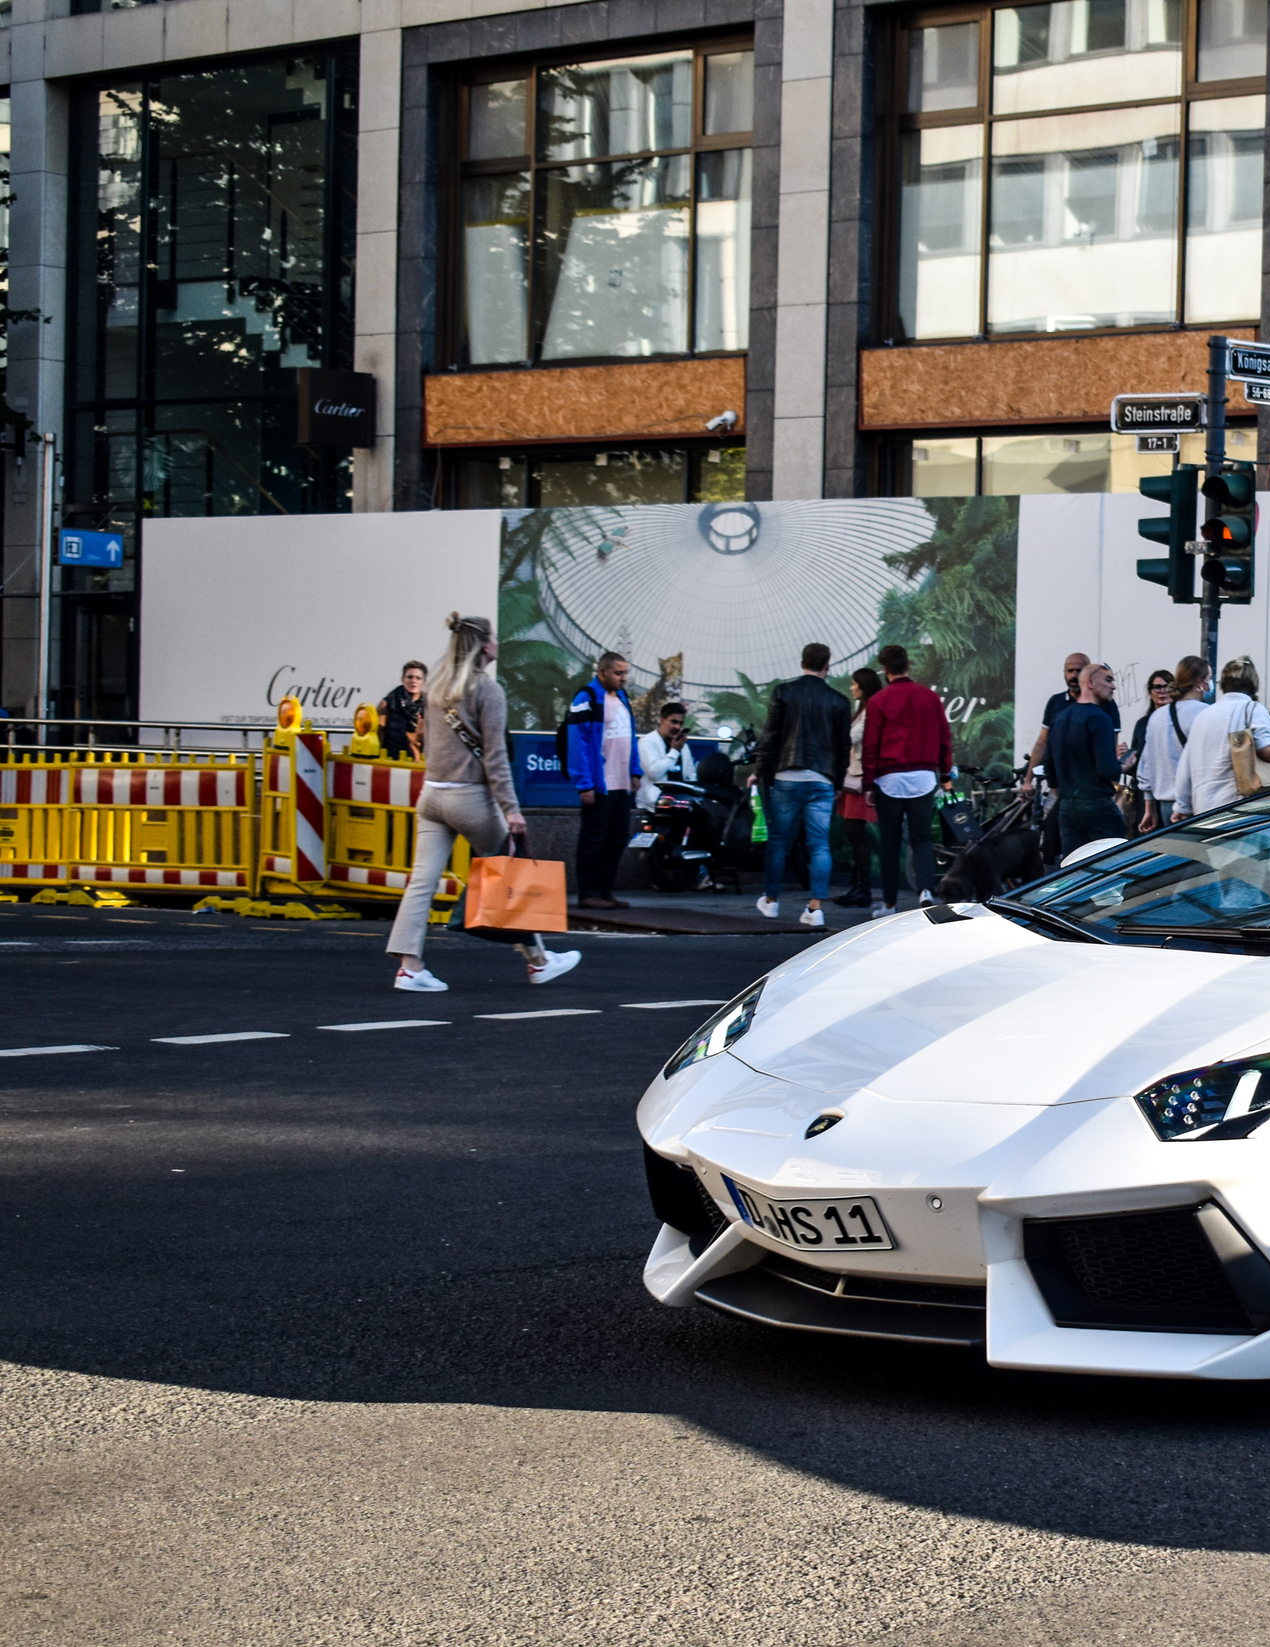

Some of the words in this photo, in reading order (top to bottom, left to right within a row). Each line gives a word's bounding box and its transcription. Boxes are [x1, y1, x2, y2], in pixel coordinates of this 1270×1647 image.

[314, 398, 366, 417] Cartier
[1124, 405, 1192, 423] Steinstraße
[1147, 437, 1168, 449] 17-1
[738, 1188, 764, 1228] D
[768, 1202, 823, 1245] HS
[823, 1204, 883, 1244] 11
